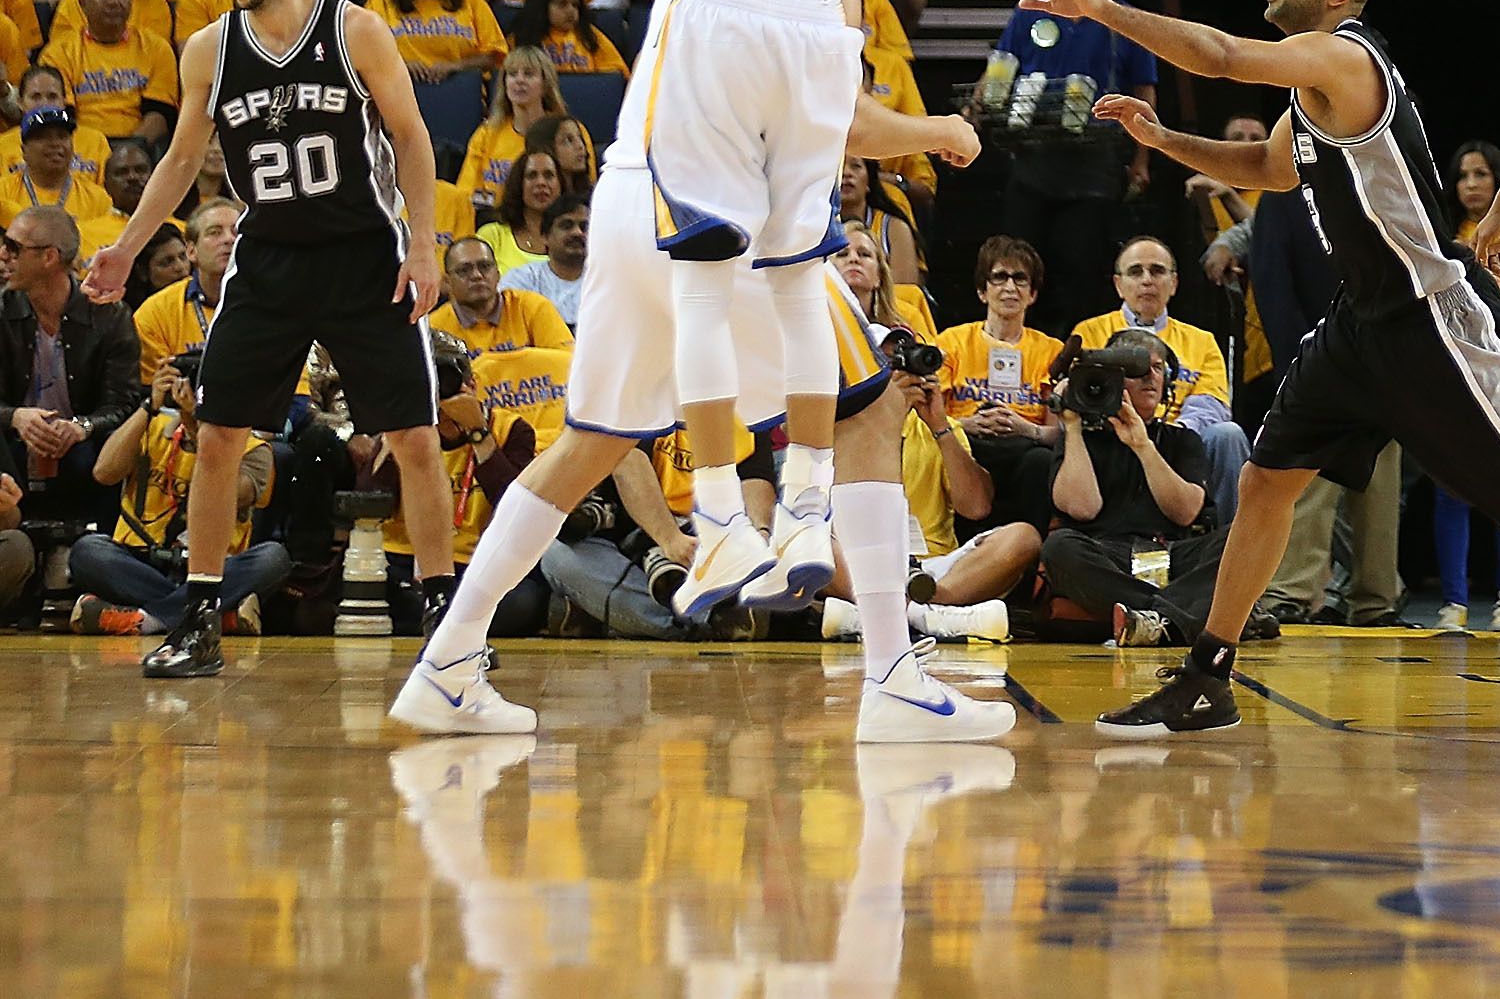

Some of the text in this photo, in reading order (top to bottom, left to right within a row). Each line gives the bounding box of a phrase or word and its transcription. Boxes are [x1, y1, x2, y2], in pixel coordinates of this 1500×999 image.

[222, 82, 349, 133] SPURS
[249, 132, 341, 203] 20
[953, 385, 1041, 404] WARRIOR
